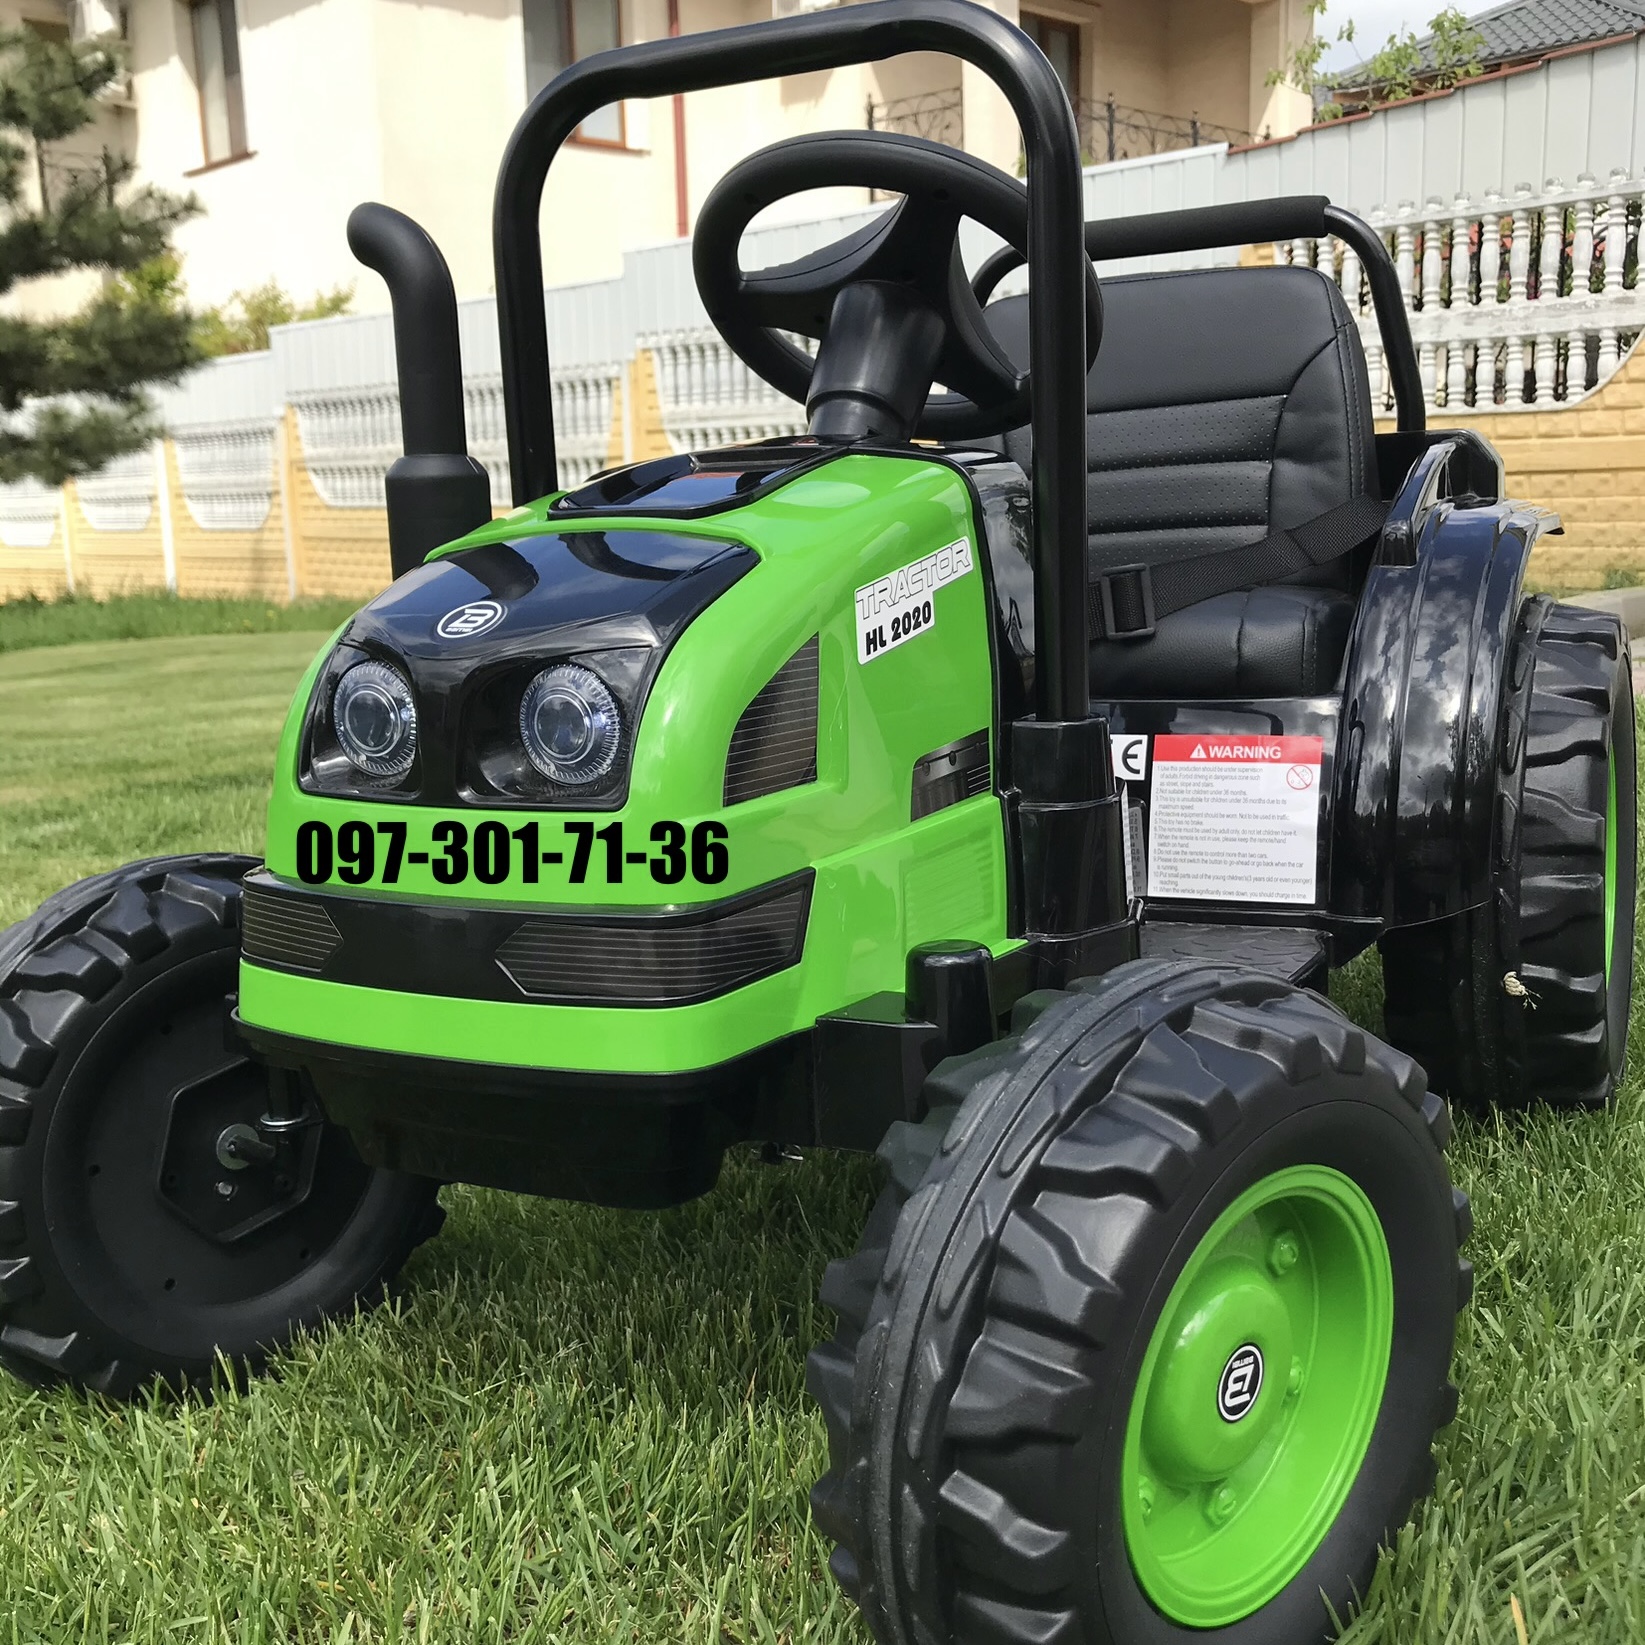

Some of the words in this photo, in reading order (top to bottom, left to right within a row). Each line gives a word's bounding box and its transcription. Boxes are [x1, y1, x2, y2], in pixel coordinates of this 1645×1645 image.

[856, 539, 971, 620] TRACTOR
[866, 625, 887, 656] HL
[891, 600, 932, 642] 2020
[1110, 739, 1143, 775] E
[1209, 745, 1281, 759] WARNING
